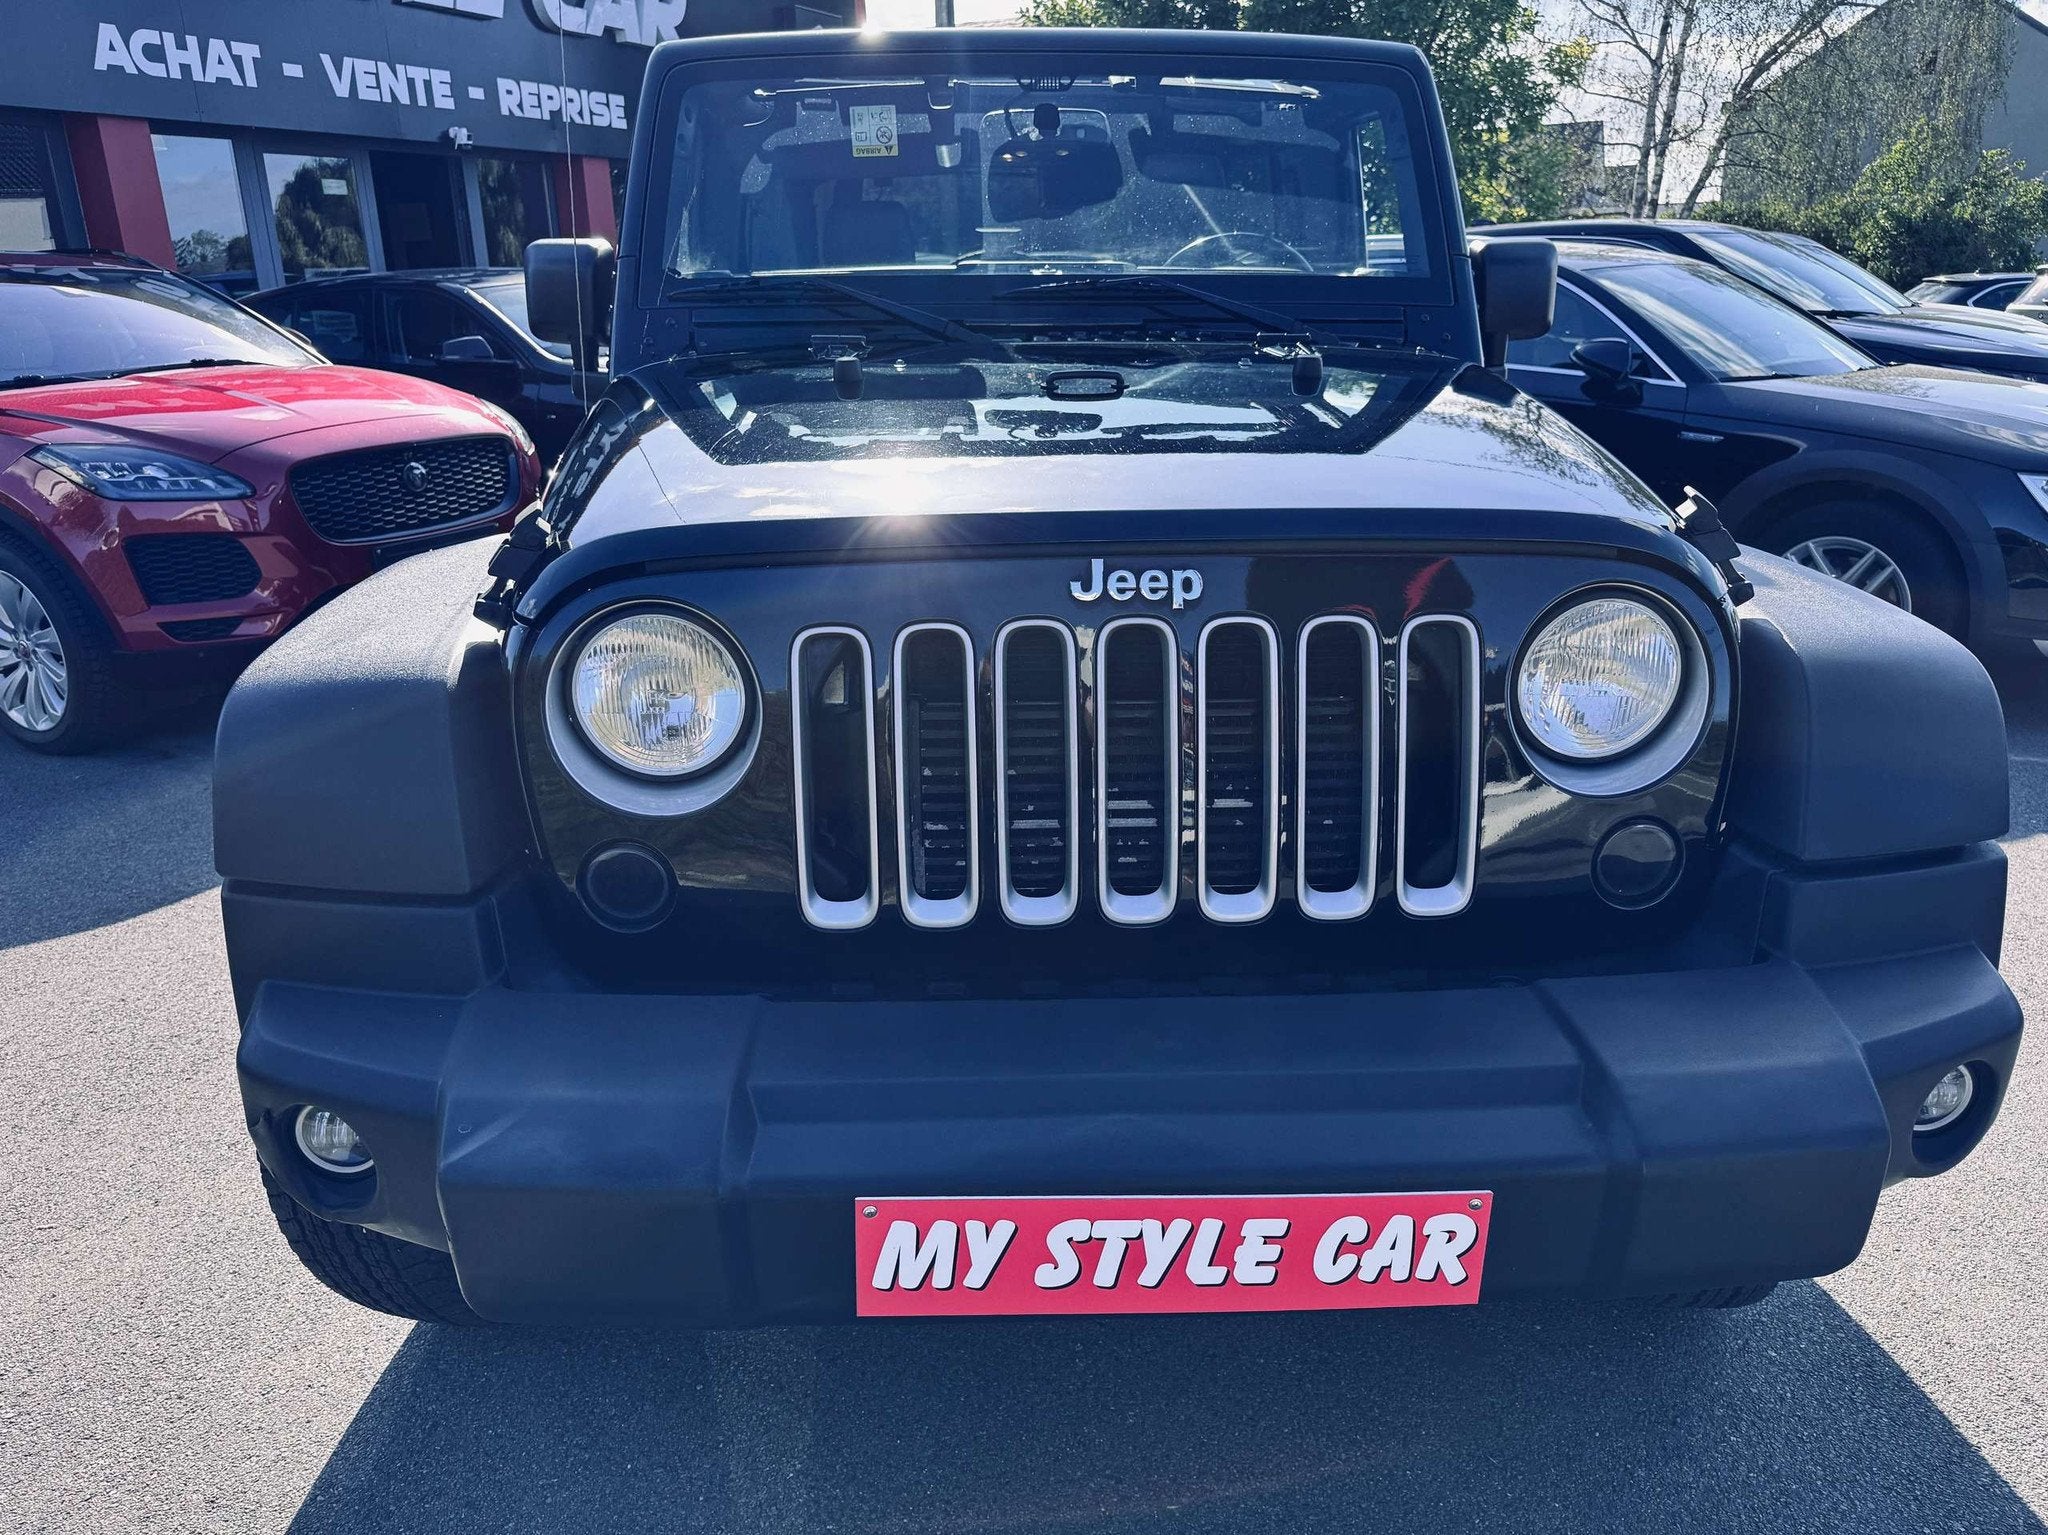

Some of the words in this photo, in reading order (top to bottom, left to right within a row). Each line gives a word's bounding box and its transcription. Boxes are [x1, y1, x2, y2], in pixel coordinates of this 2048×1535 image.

[94, 22, 262, 88] ACHAT
[319, 53, 456, 110] VENTE
[496, 77, 628, 130] REPRISE
[855, 147, 882, 155] AIRBAG
[1069, 558, 1204, 610] Jeep
[871, 1219, 1017, 1291] MY
[1034, 1217, 1293, 1290] STYLE
[1312, 1212, 1479, 1287] CAR
